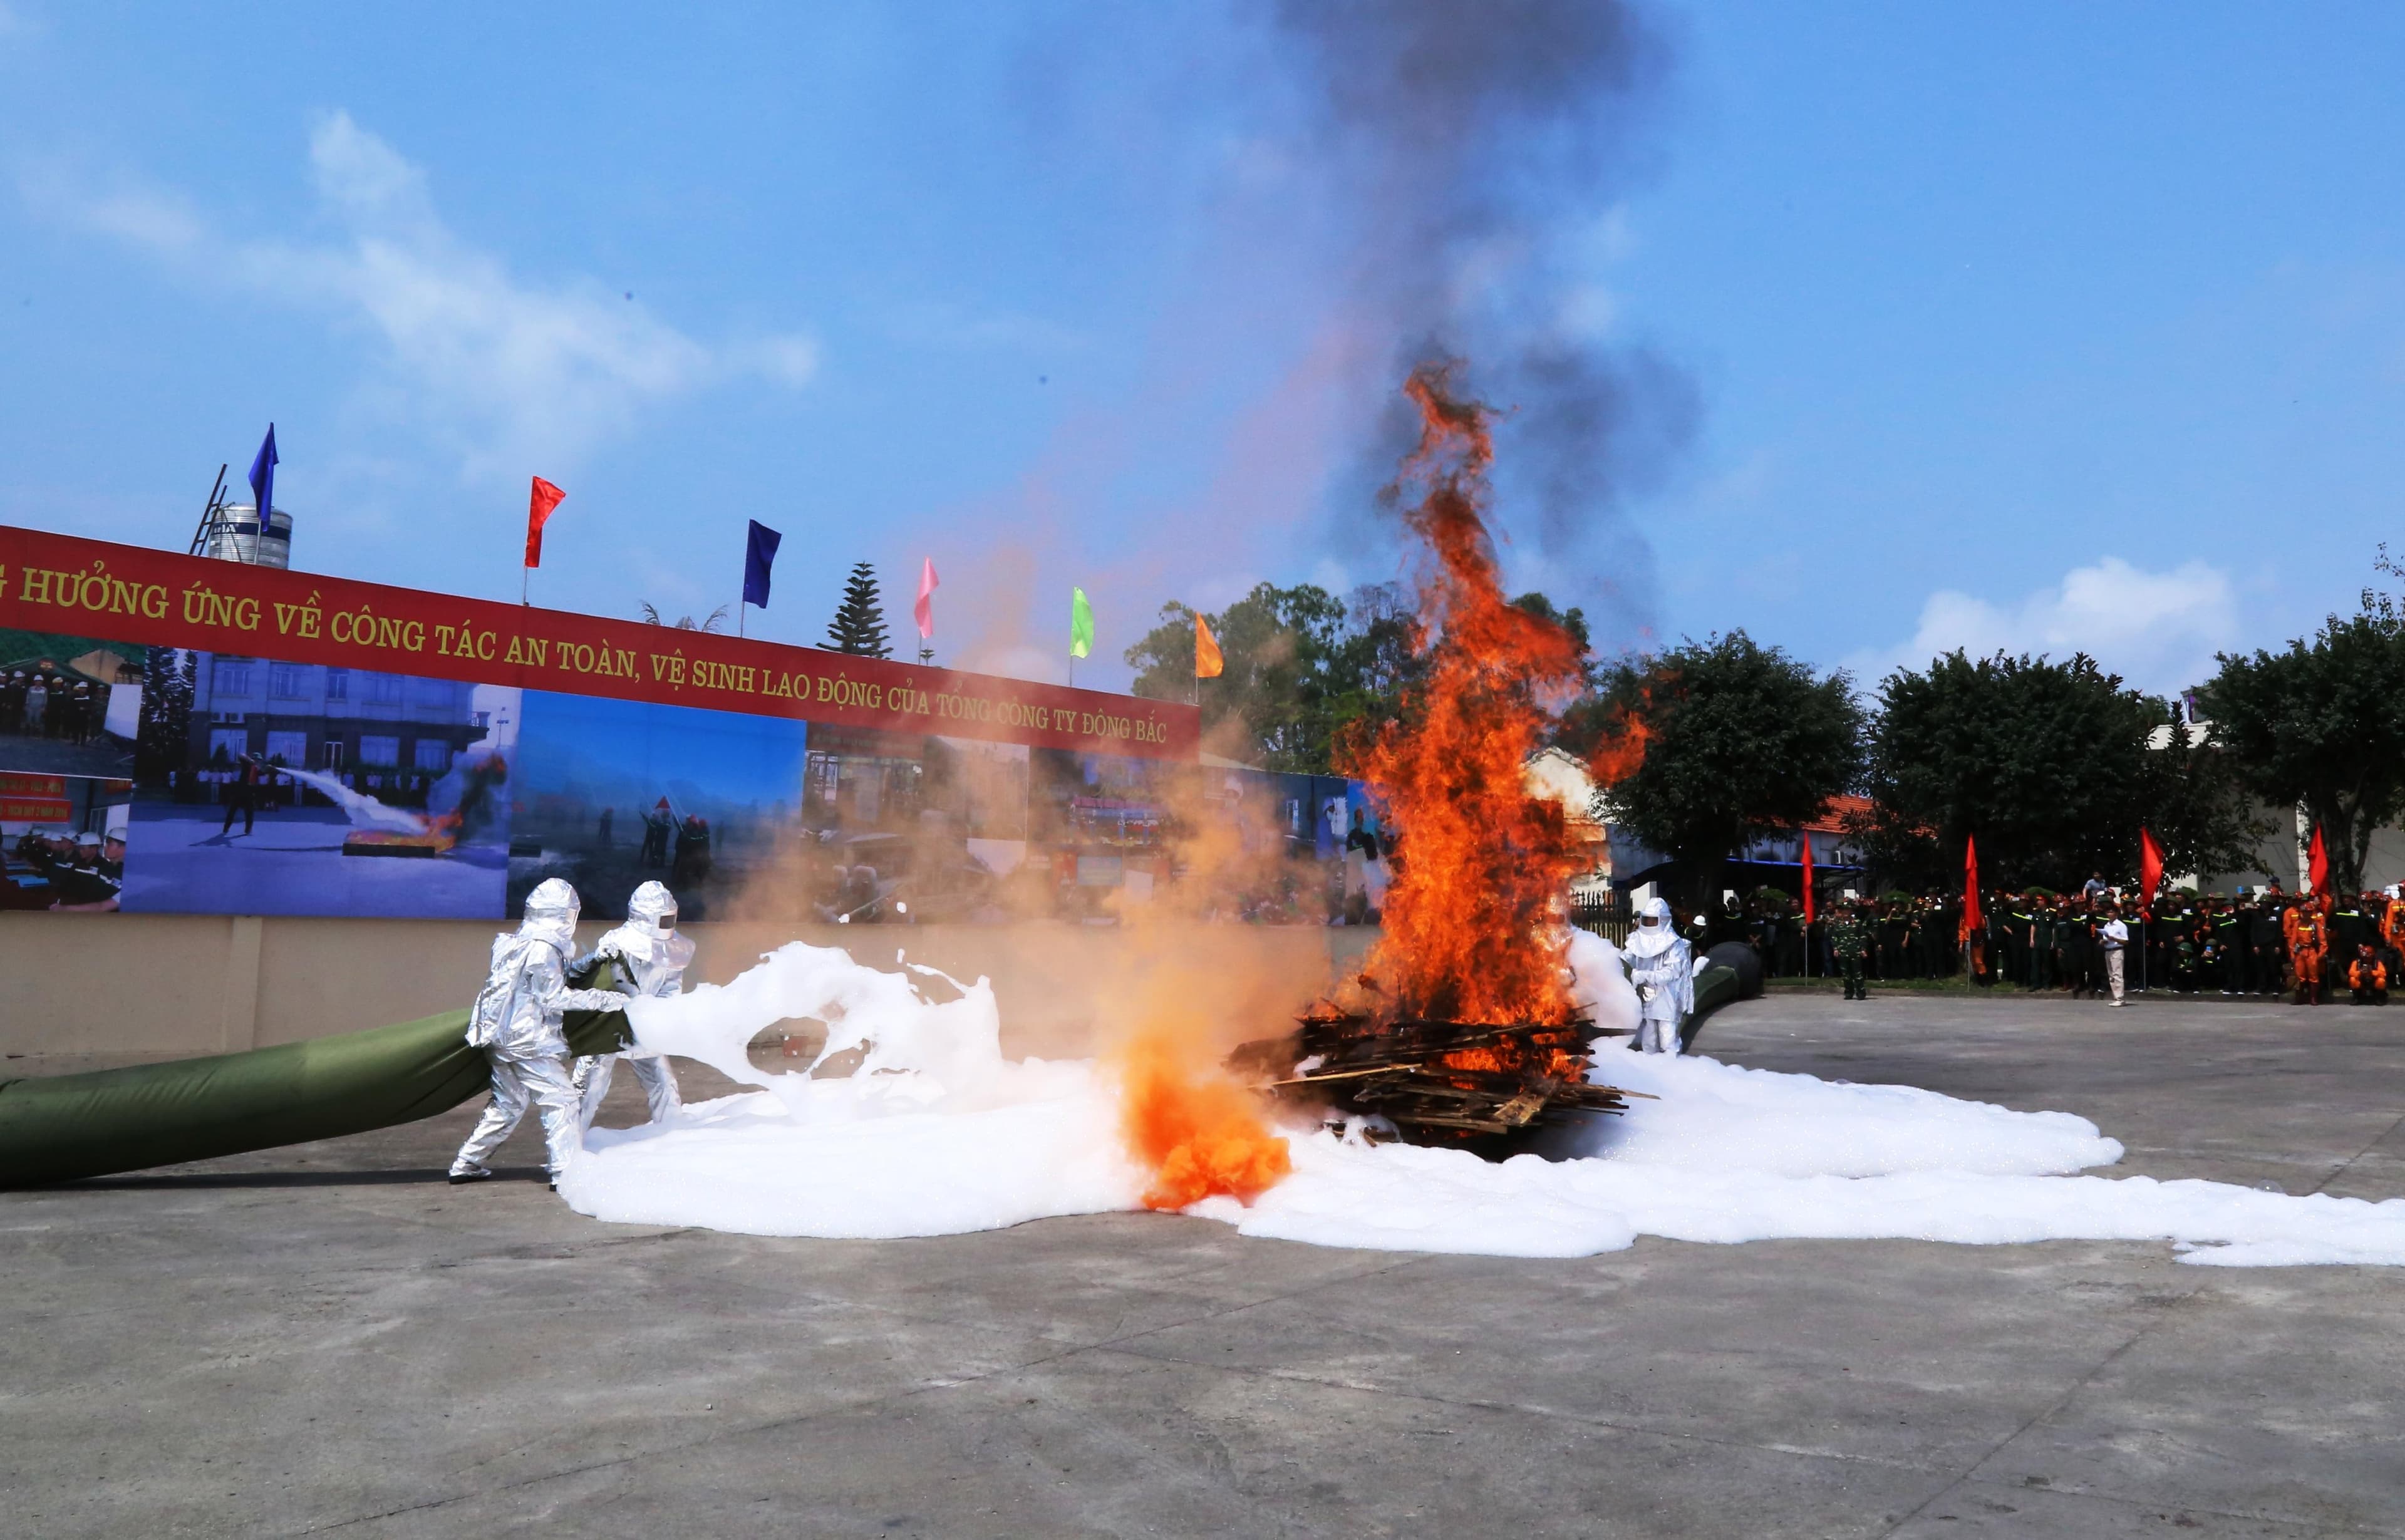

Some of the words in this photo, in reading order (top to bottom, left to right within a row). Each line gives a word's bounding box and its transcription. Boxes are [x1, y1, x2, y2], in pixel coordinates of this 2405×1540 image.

[19, 561, 170, 619] HƯỞNG
[182, 581, 261, 631] ỨNG
[274, 590, 321, 639] VỀ
[331, 605, 426, 652] CÔNG
[435, 619, 497, 661] TÁC
[504, 635, 549, 667] AN
[557, 639, 640, 683] TOÀN,
[650, 648, 686, 691] VỆ
[692, 659, 755, 693] SINH
[762, 669, 810, 700] LAO
[817, 672, 882, 711] ĐỘNG
[887, 678, 929, 715] CỦA
[937, 681, 991, 722] TỔNG
[996, 696, 1049, 730] CÔNG
[1053, 709, 1077, 732] TY
[1082, 708, 1130, 738] ĐÔNG
[1137, 709, 1167, 743] BẮC
